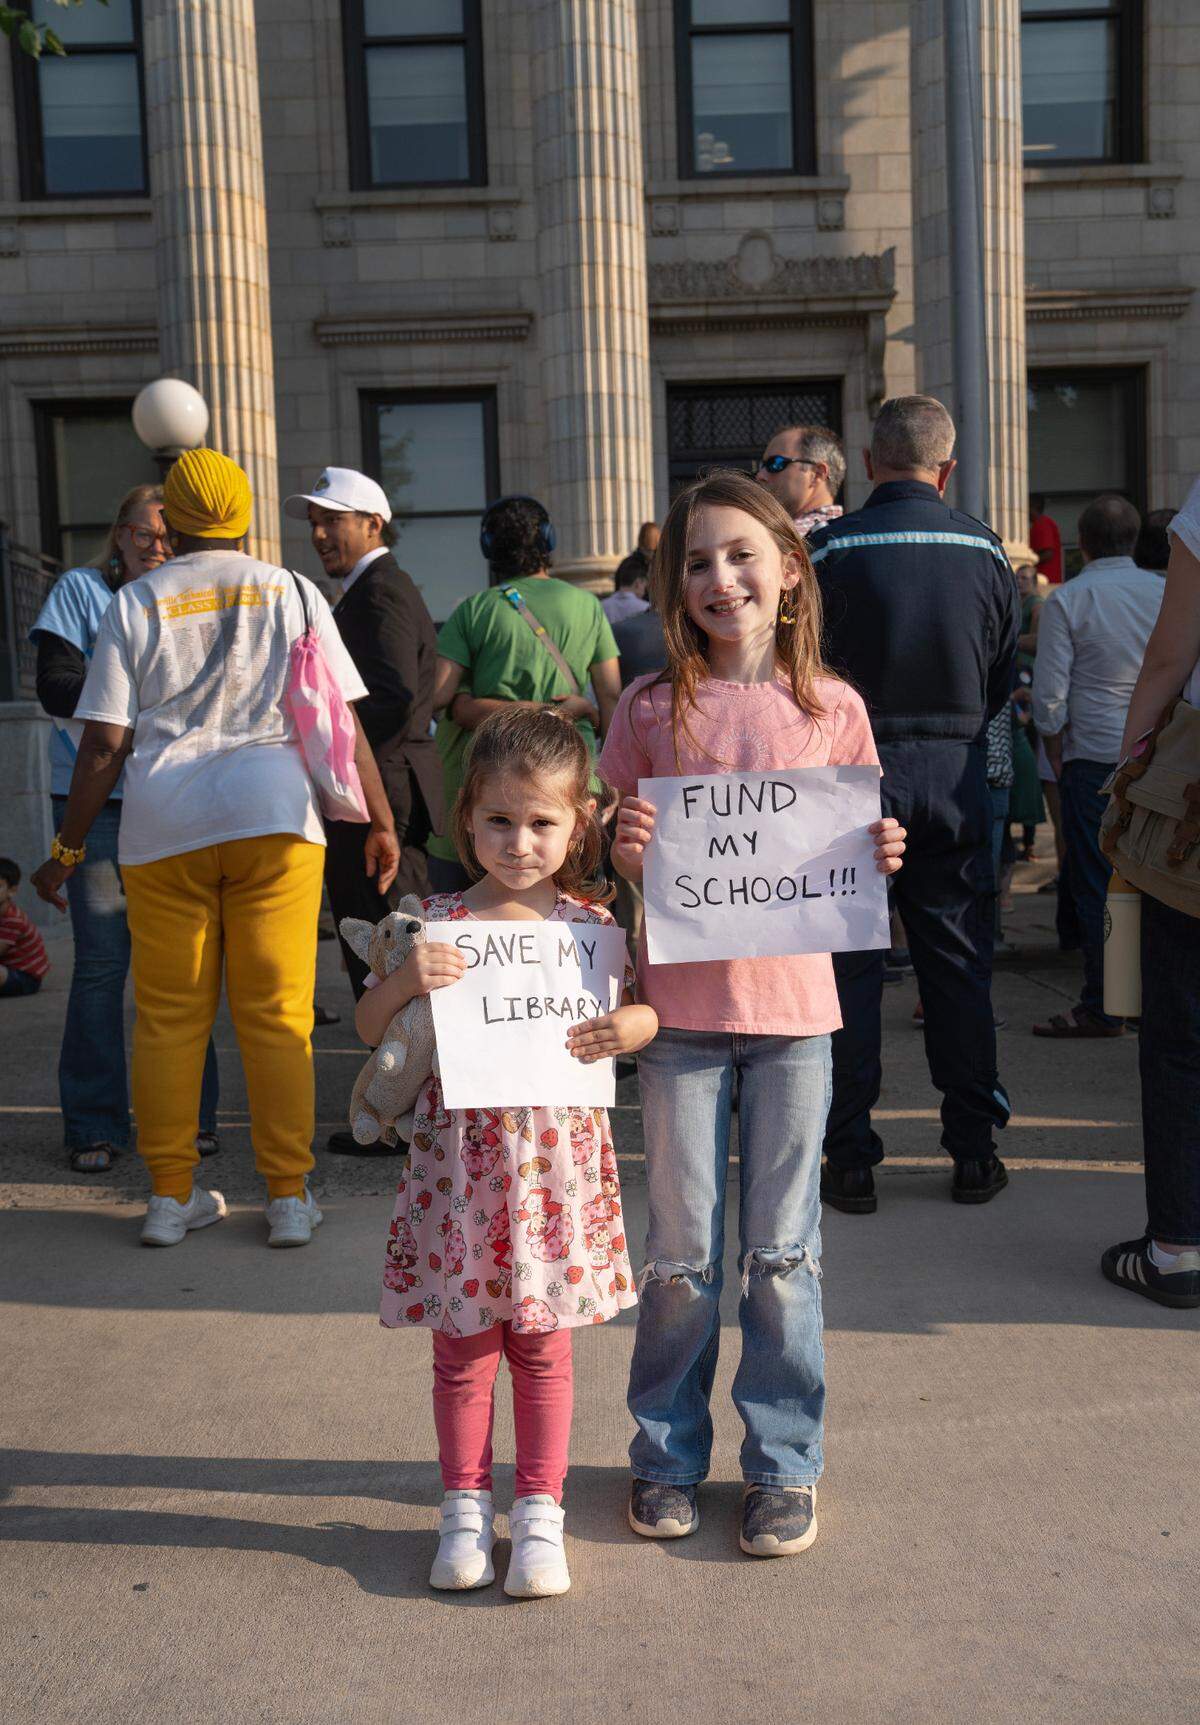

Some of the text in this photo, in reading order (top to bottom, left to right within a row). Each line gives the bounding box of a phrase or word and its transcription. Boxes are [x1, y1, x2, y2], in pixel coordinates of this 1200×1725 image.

[682, 781, 797, 819] FUND
[708, 830, 758, 858] MY
[675, 867, 857, 909] SCHOOL!!!
[455, 933, 596, 970] SAVE MY
